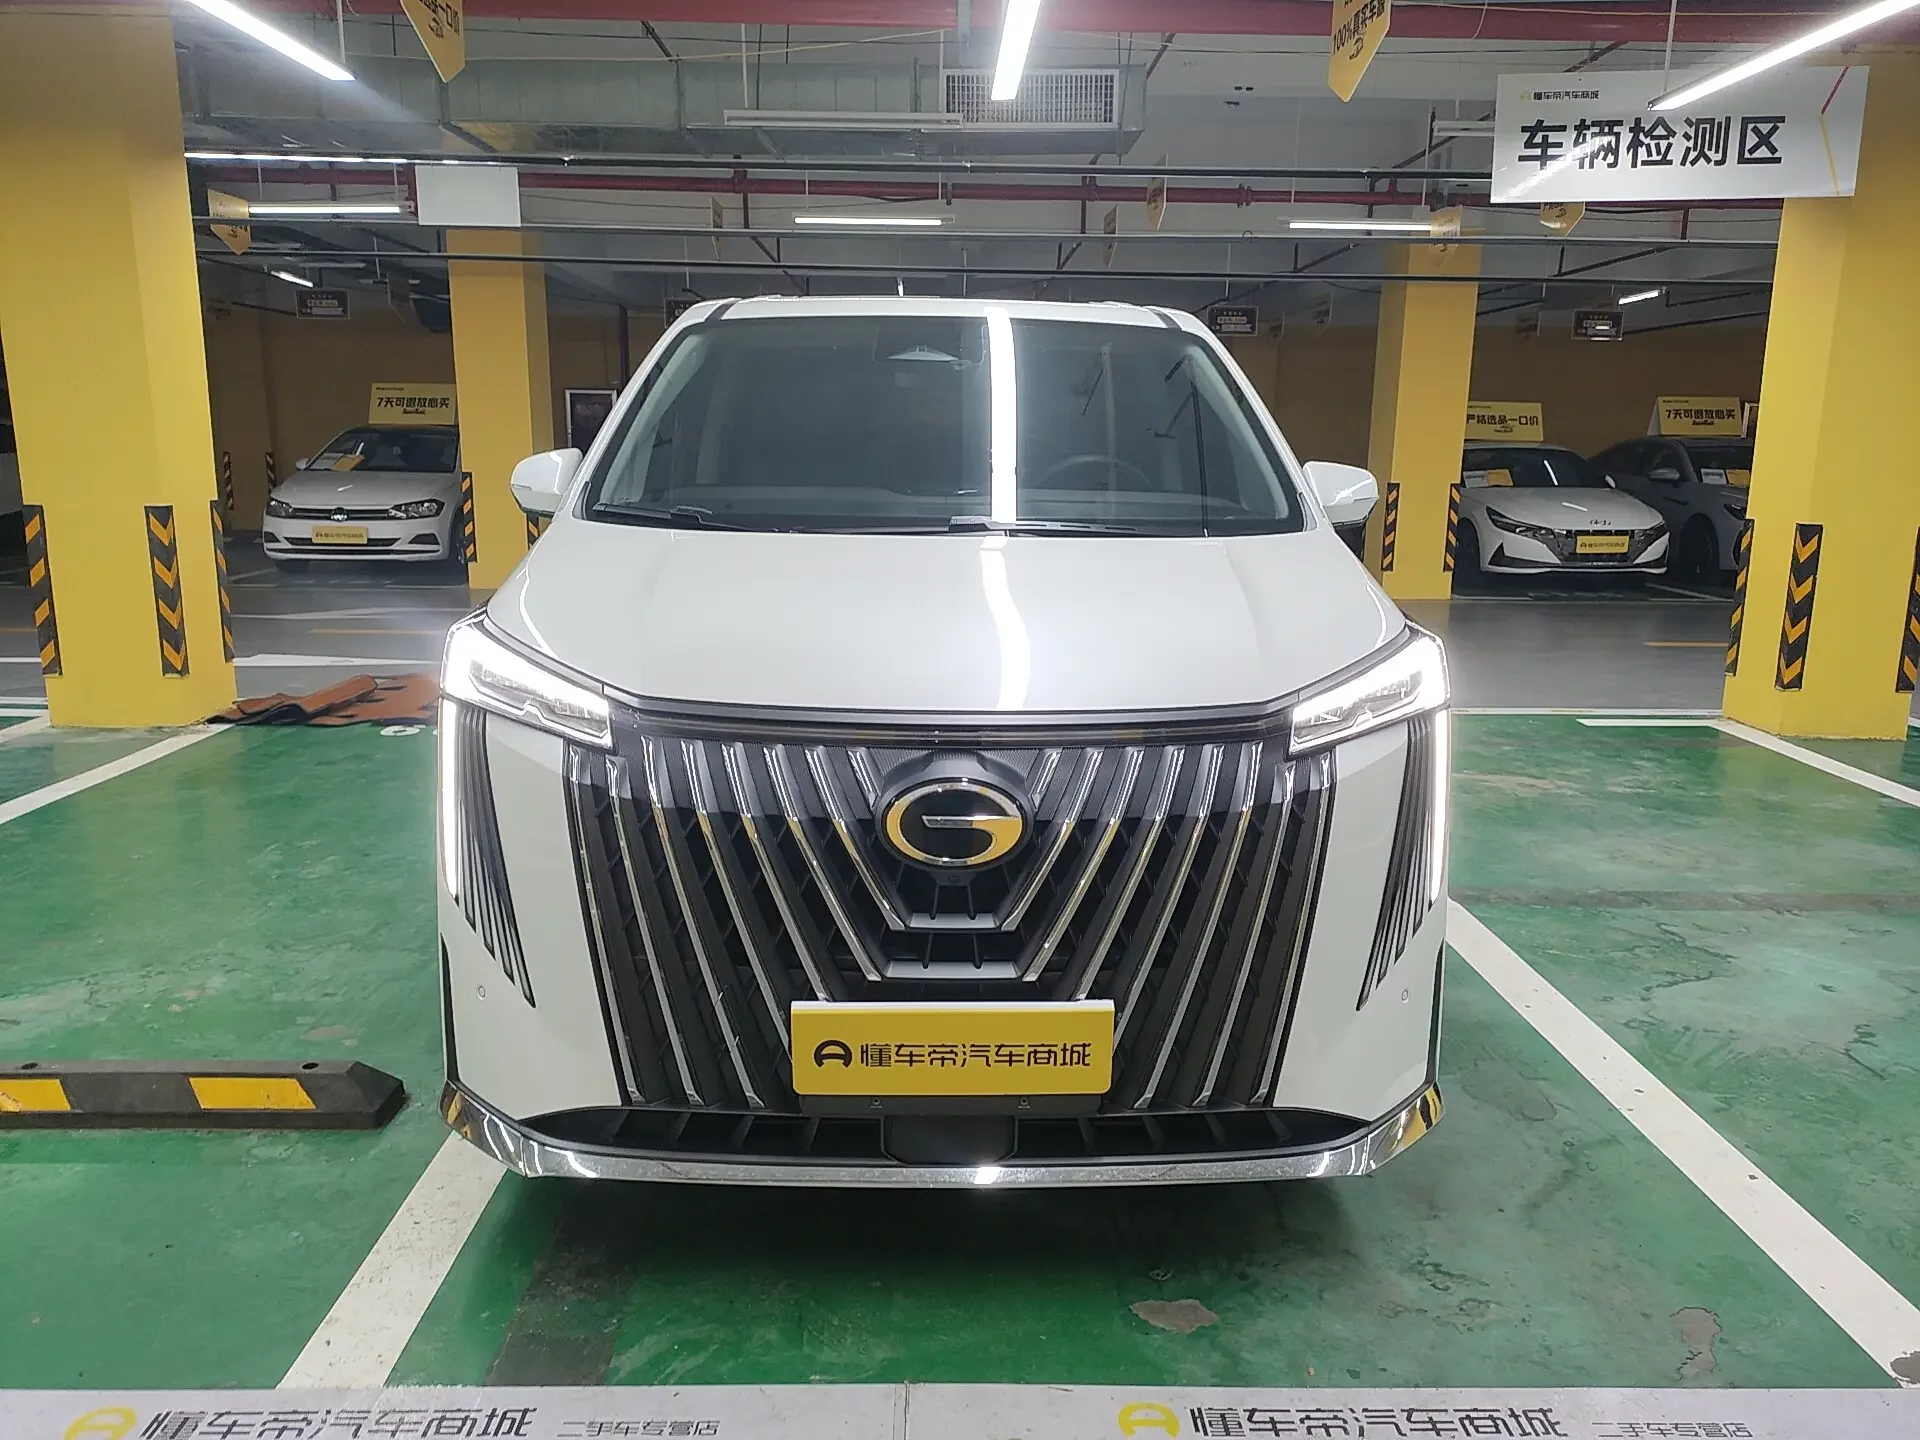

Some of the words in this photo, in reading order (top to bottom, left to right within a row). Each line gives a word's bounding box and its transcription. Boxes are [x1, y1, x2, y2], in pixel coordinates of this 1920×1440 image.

[1518, 116, 1786, 170] 车辆检测区
[377, 396, 450, 409] 7天可退放心买
[860, 1042, 1092, 1068] 懂车帝汽车商城
[139, 1407, 537, 1440] 懂车帝汽车商城
[557, 1420, 720, 1438] 二手车专营店
[1189, 1407, 1569, 1438] 懂车帝汽车商城
[1592, 1421, 1753, 1439] 二手车专营店
